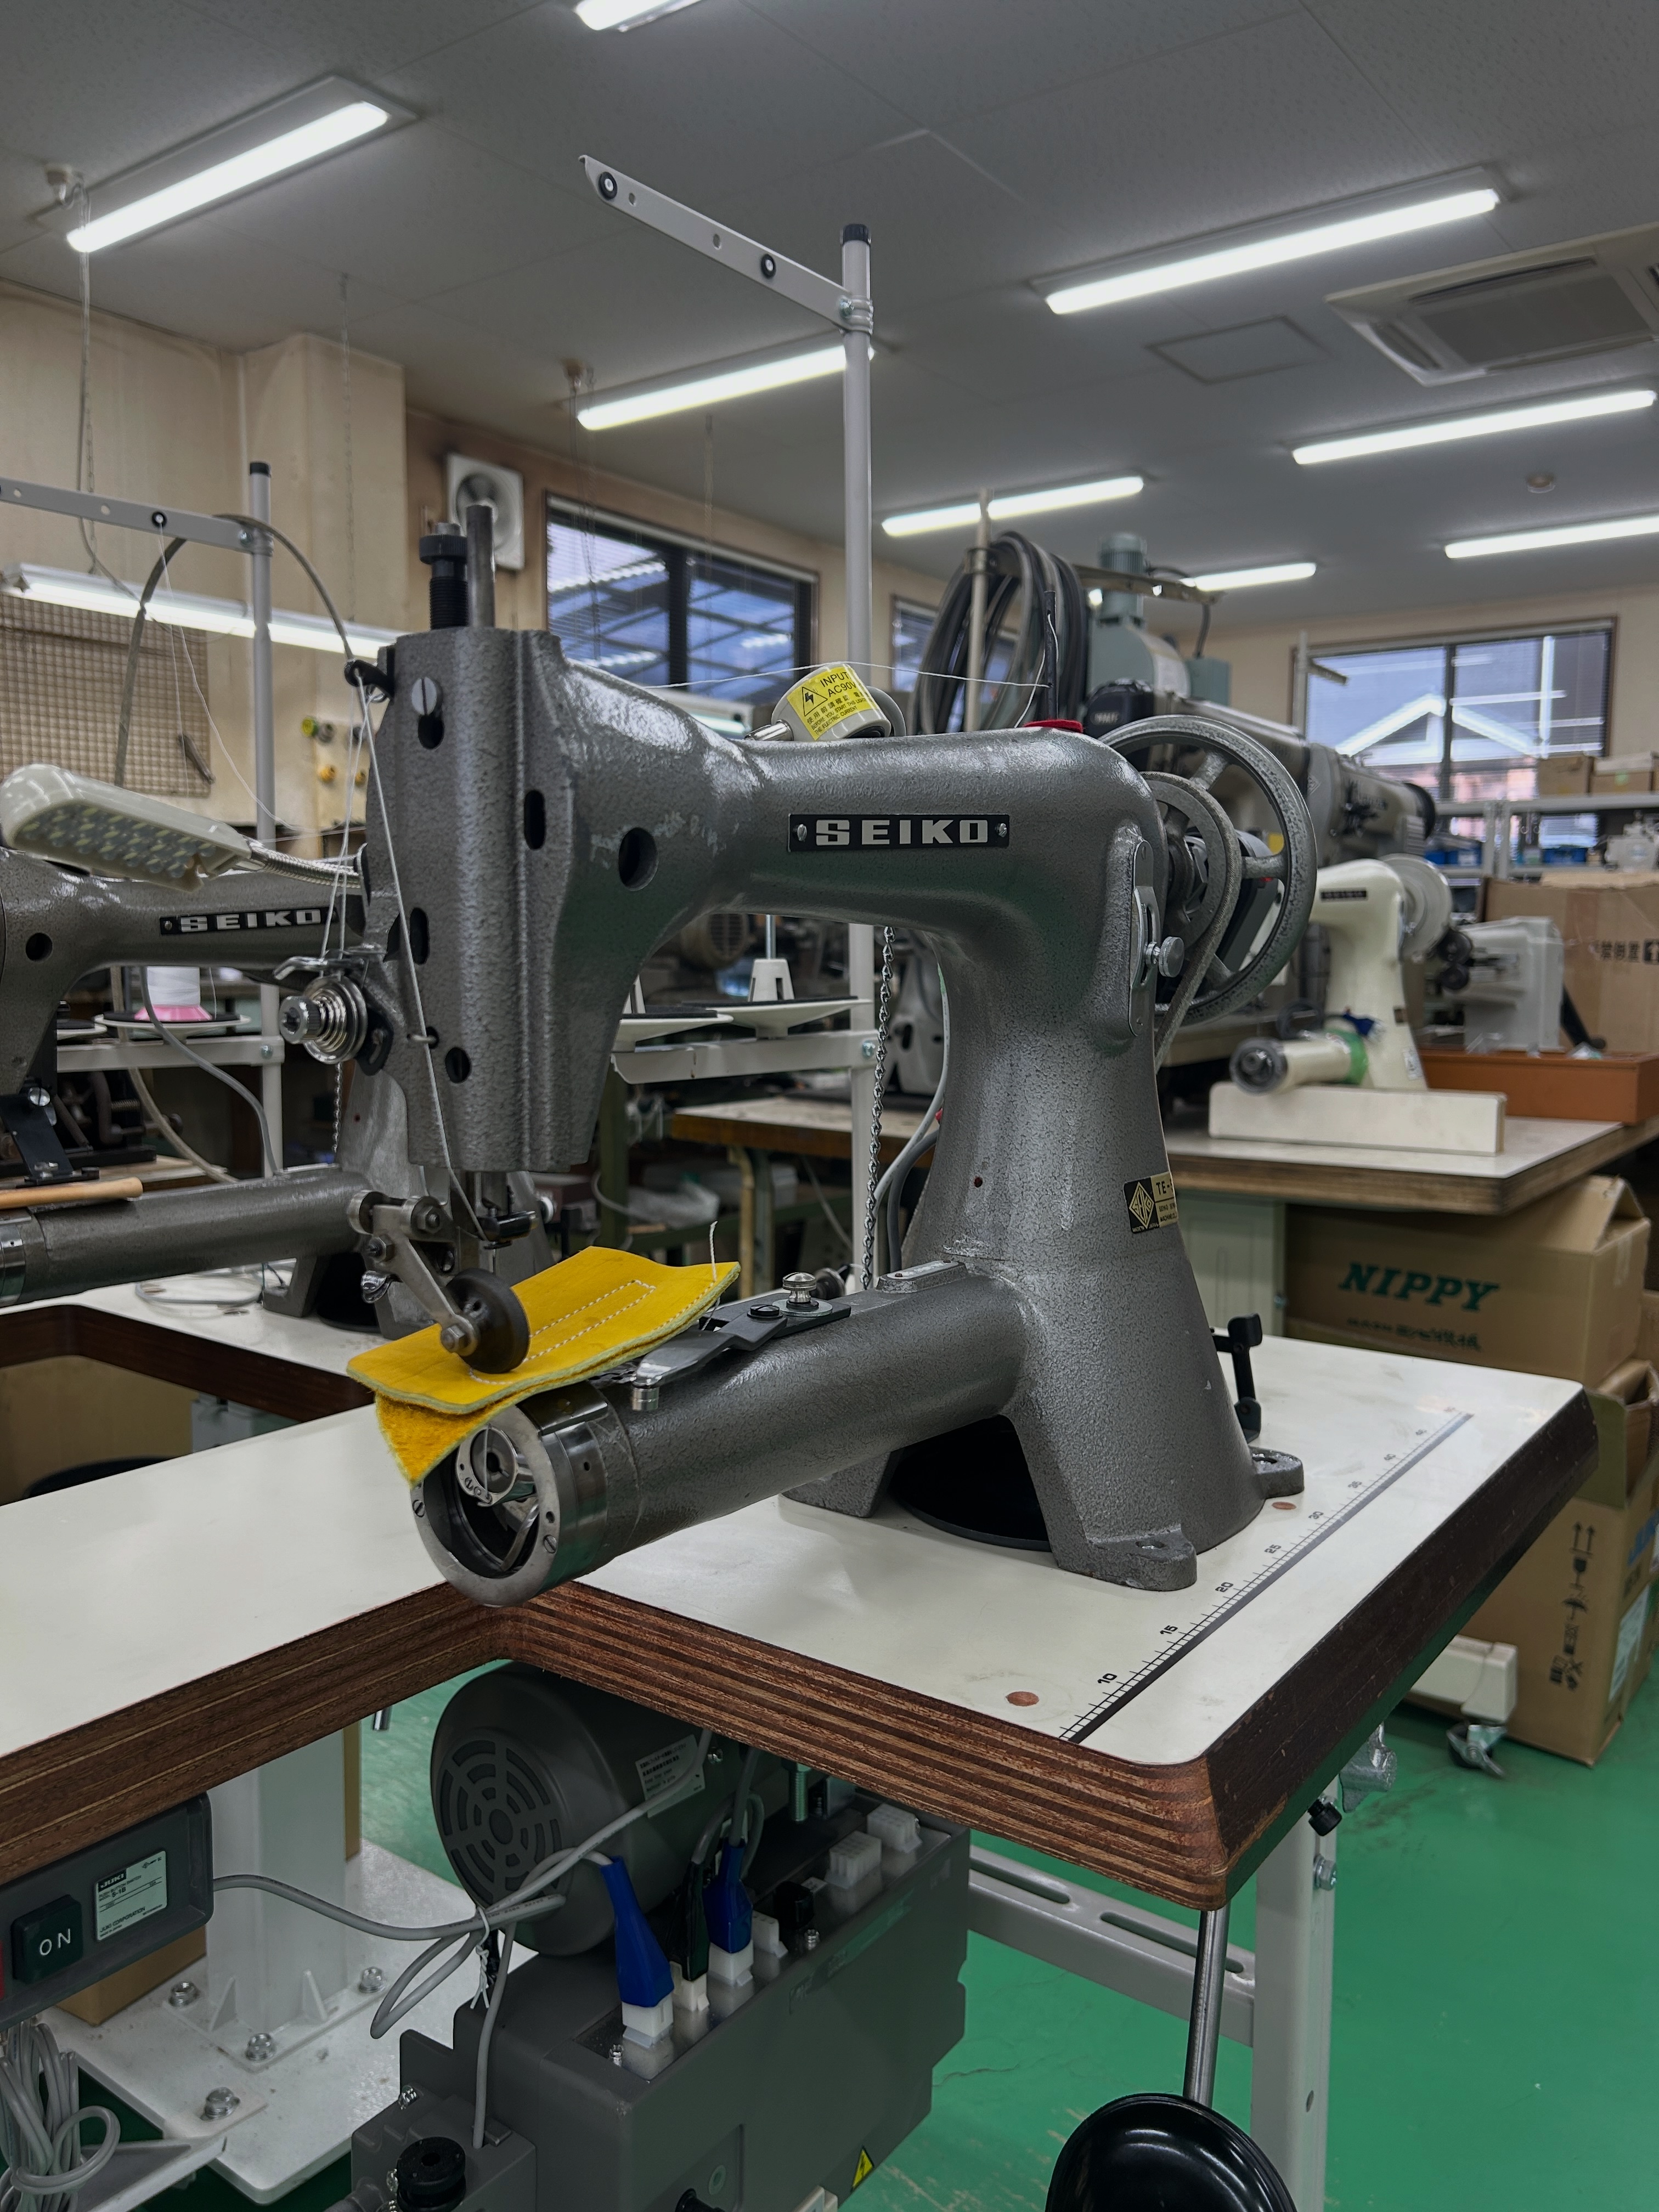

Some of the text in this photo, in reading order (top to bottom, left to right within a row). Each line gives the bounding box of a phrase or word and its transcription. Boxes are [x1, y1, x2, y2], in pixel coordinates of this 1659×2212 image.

[820, 672, 849, 687] INPUT
[811, 717, 826, 730] BEFORE
[834, 704, 847, 713] START
[822, 714, 840, 729] ELECTRIC
[816, 819, 988, 846] SEIKO
[180, 909, 321, 933] SEIKO
[1338, 1262, 1500, 1311] NIPPY
[1097, 1673, 1118, 1684] 10
[1160, 1624, 1178, 1635] 15
[1215, 1582, 1234, 1593] 20
[1264, 1544, 1282, 1554] 25
[1308, 1511, 1324, 1520] 30
[100, 1873, 125, 1888] JUKI
[112, 1906, 145, 1926] CORPORATION
[40, 1928, 71, 1956] ON
